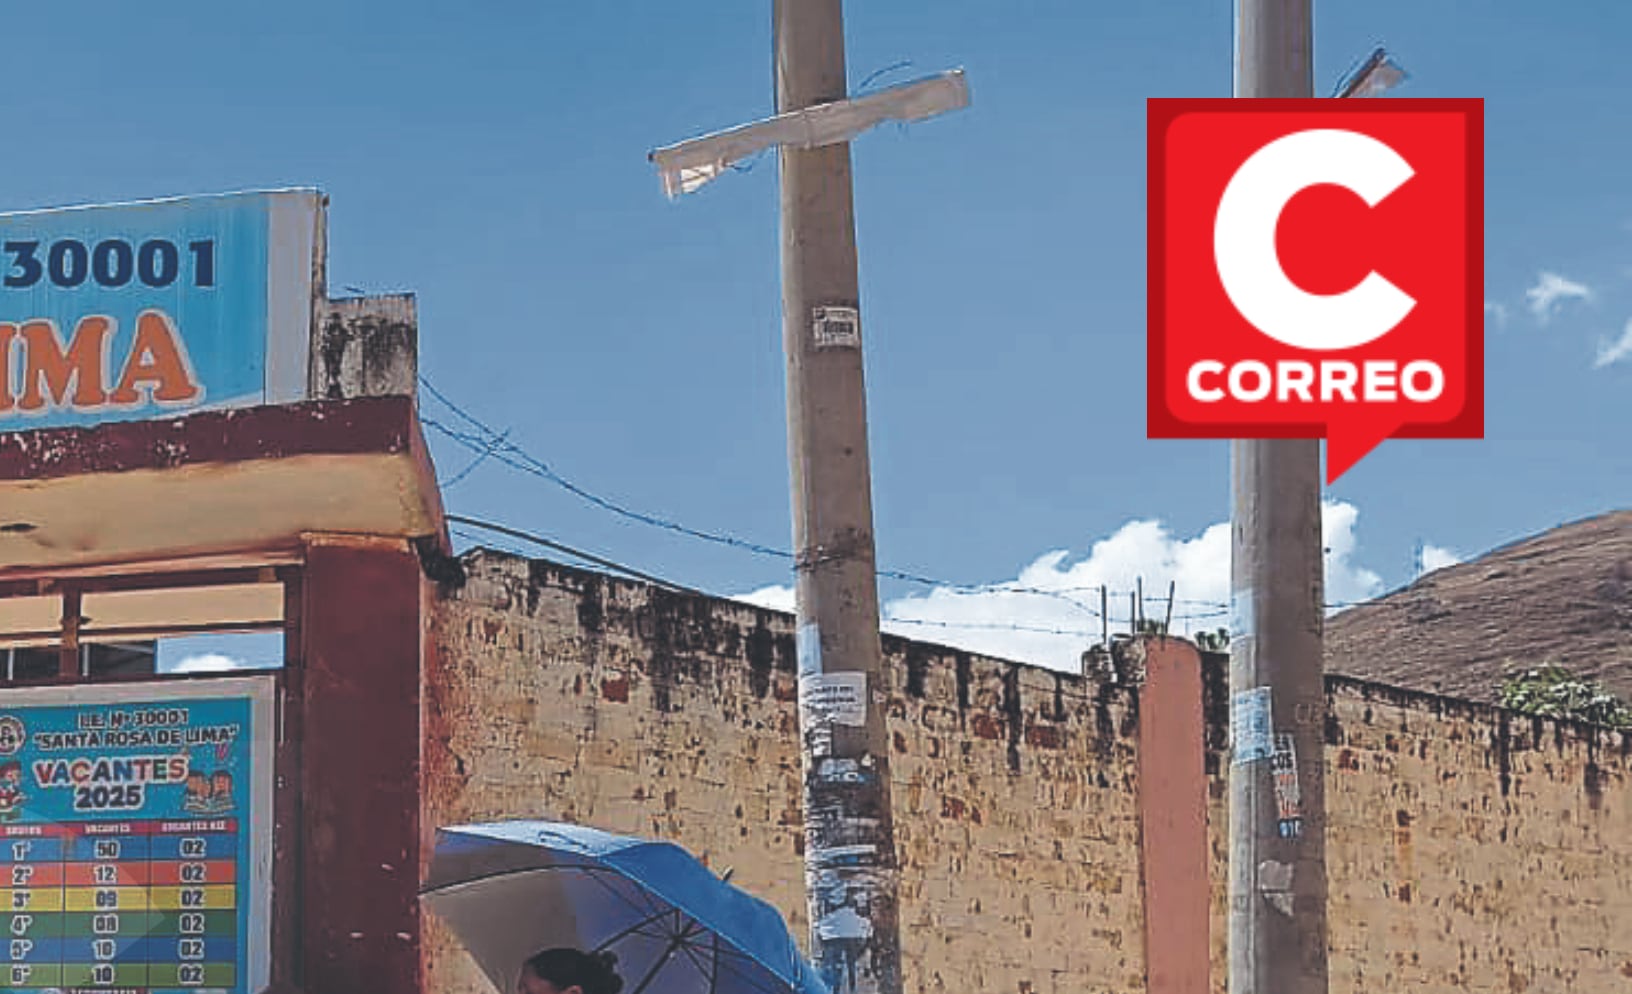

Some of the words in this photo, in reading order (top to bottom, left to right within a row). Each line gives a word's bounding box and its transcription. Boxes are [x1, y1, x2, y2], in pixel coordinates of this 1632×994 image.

[3, 239, 215, 289] 30001
[105, 728, 153, 748] ROSA
[156, 727, 183, 746] DE
[33, 755, 189, 787] VACANTES
[73, 784, 146, 811] 2025
[94, 838, 119, 858] 50
[180, 837, 206, 857] 02
[94, 864, 117, 883] 12
[180, 863, 205, 883] 02
[180, 889, 205, 909] 02
[179, 913, 204, 934] 02
[92, 939, 115, 960] 10
[179, 938, 204, 960] 02
[92, 965, 114, 985] 10
[178, 964, 204, 985] 02
